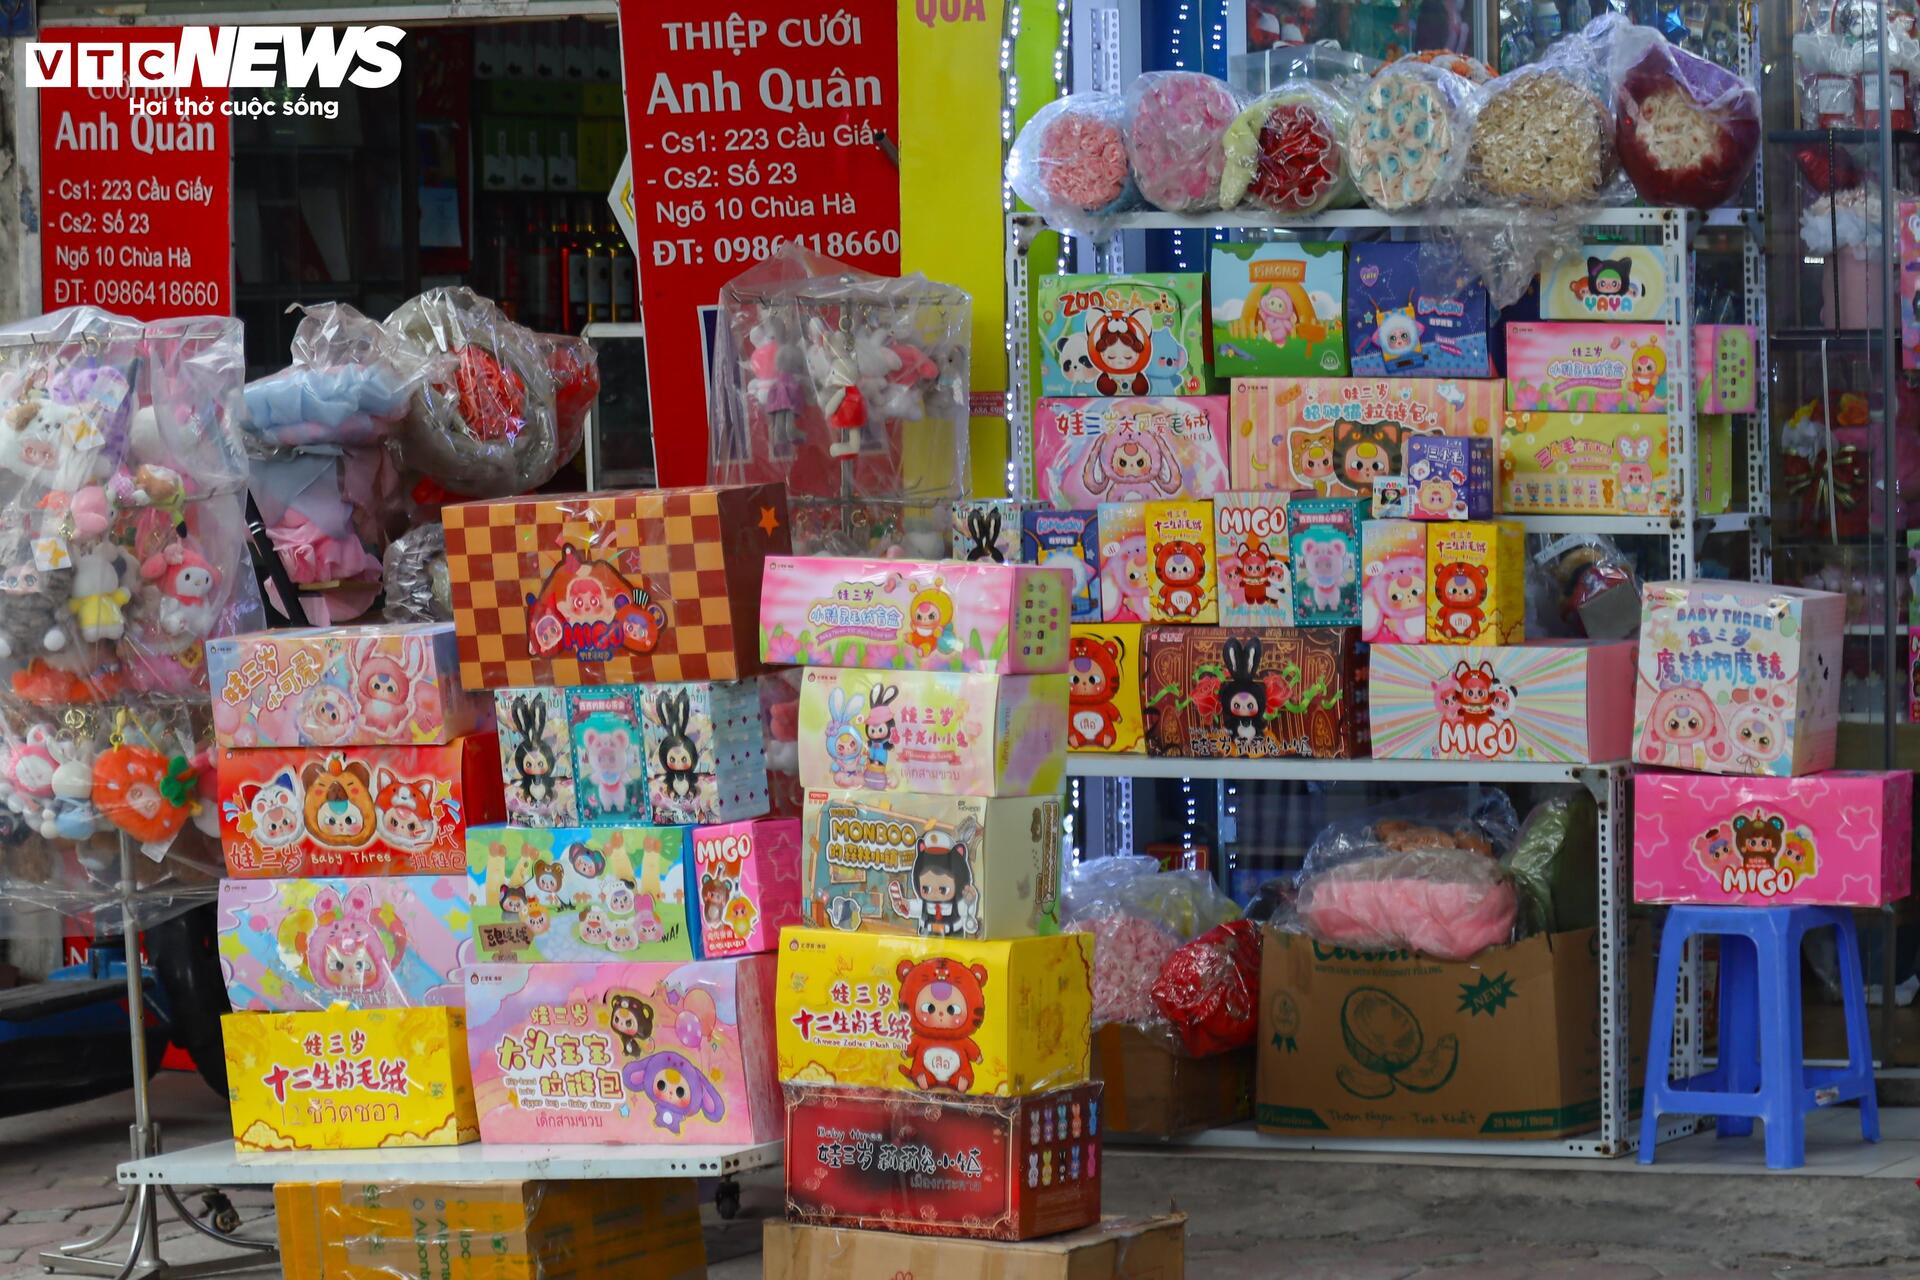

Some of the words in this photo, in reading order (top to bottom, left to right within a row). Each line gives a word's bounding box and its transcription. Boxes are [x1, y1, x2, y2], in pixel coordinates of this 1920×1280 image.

[661, 12, 768, 57] THIỆP
[777, 8, 862, 47] CƯỚI
[646, 70, 742, 115] Anh
[758, 67, 882, 113] Quân
[55, 111, 119, 151] Anh
[130, 111, 216, 155] Quân
[661, 130, 716, 154] Cs1:
[724, 128, 769, 151] 223
[777, 122, 825, 149] Cầu
[833, 119, 888, 150] Giấ
[664, 165, 719, 190] Cs2:
[727, 159, 760, 187] Số
[767, 162, 797, 185] 23
[59, 179, 96, 201] Cs1:
[101, 180, 132, 201] 223
[137, 175, 171, 201] Cầu
[176, 176, 213, 207] Giấy
[60, 213, 96, 234] Cs2:
[102, 210, 124, 235] Số
[129, 213, 150, 234] 23
[656, 200, 706, 228] Ngõ
[714, 198, 743, 220] 10
[751, 195, 815, 219] Chùa
[822, 193, 856, 215] Hà
[55, 246, 90, 270] Ngõ
[95, 248, 114, 268] 10
[119, 244, 162, 268] Chùa
[168, 244, 192, 267] Hà
[653, 239, 704, 267] ĐT:
[54, 280, 88, 304] ĐT:
[94, 281, 219, 306] 0986418660
[1060, 291, 1105, 317] ZOO
[1585, 296, 1632, 313] YAYA
[1343, 383, 1389, 400] 娃三岁
[1219, 506, 1287, 537] MIGO
[1677, 608, 1718, 622] BABY
[1722, 608, 1773, 631] THREE
[1687, 625, 1752, 647] 娃三岁
[1439, 719, 1518, 758] MIGO
[831, 820, 916, 847] MONBOO
[230, 843, 304, 873] 娃三岁
[311, 852, 343, 865] Baby
[352, 851, 392, 863] Three
[696, 834, 752, 864] MIGO
[1721, 867, 1795, 897] MIGO
[831, 983, 893, 1005] 娃三岁
[1474, 985, 1503, 1008] NEW
[530, 1004, 588, 1026] 娃三岁
[303, 1029, 367, 1057] 娃三岁
[263, 1059, 409, 1104] 十二生肖毛绒
[817, 1140, 873, 1171] 娃三岁
